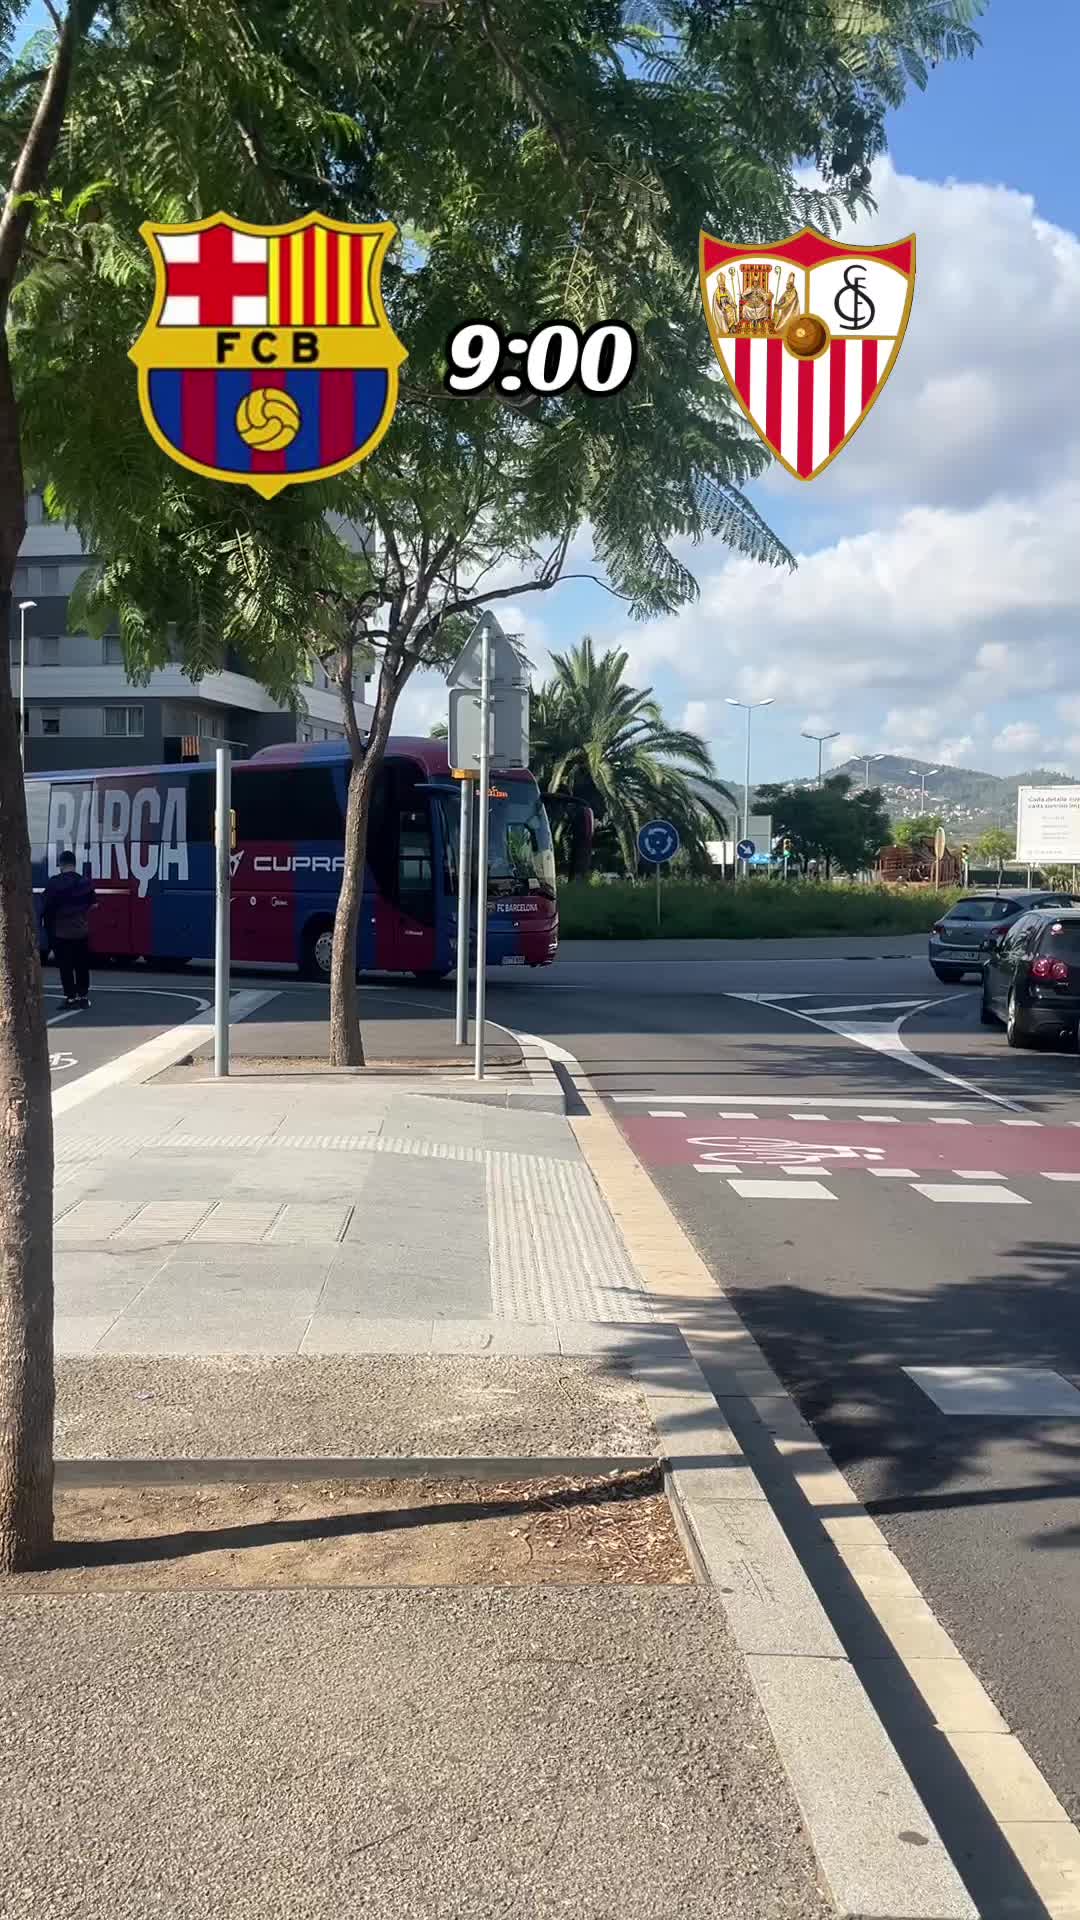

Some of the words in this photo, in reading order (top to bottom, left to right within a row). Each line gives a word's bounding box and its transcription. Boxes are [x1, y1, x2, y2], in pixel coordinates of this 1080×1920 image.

[47, 787, 189, 898] BARÇA
[496, 903, 504, 912] FC
[505, 903, 538, 912] BARCELONA
